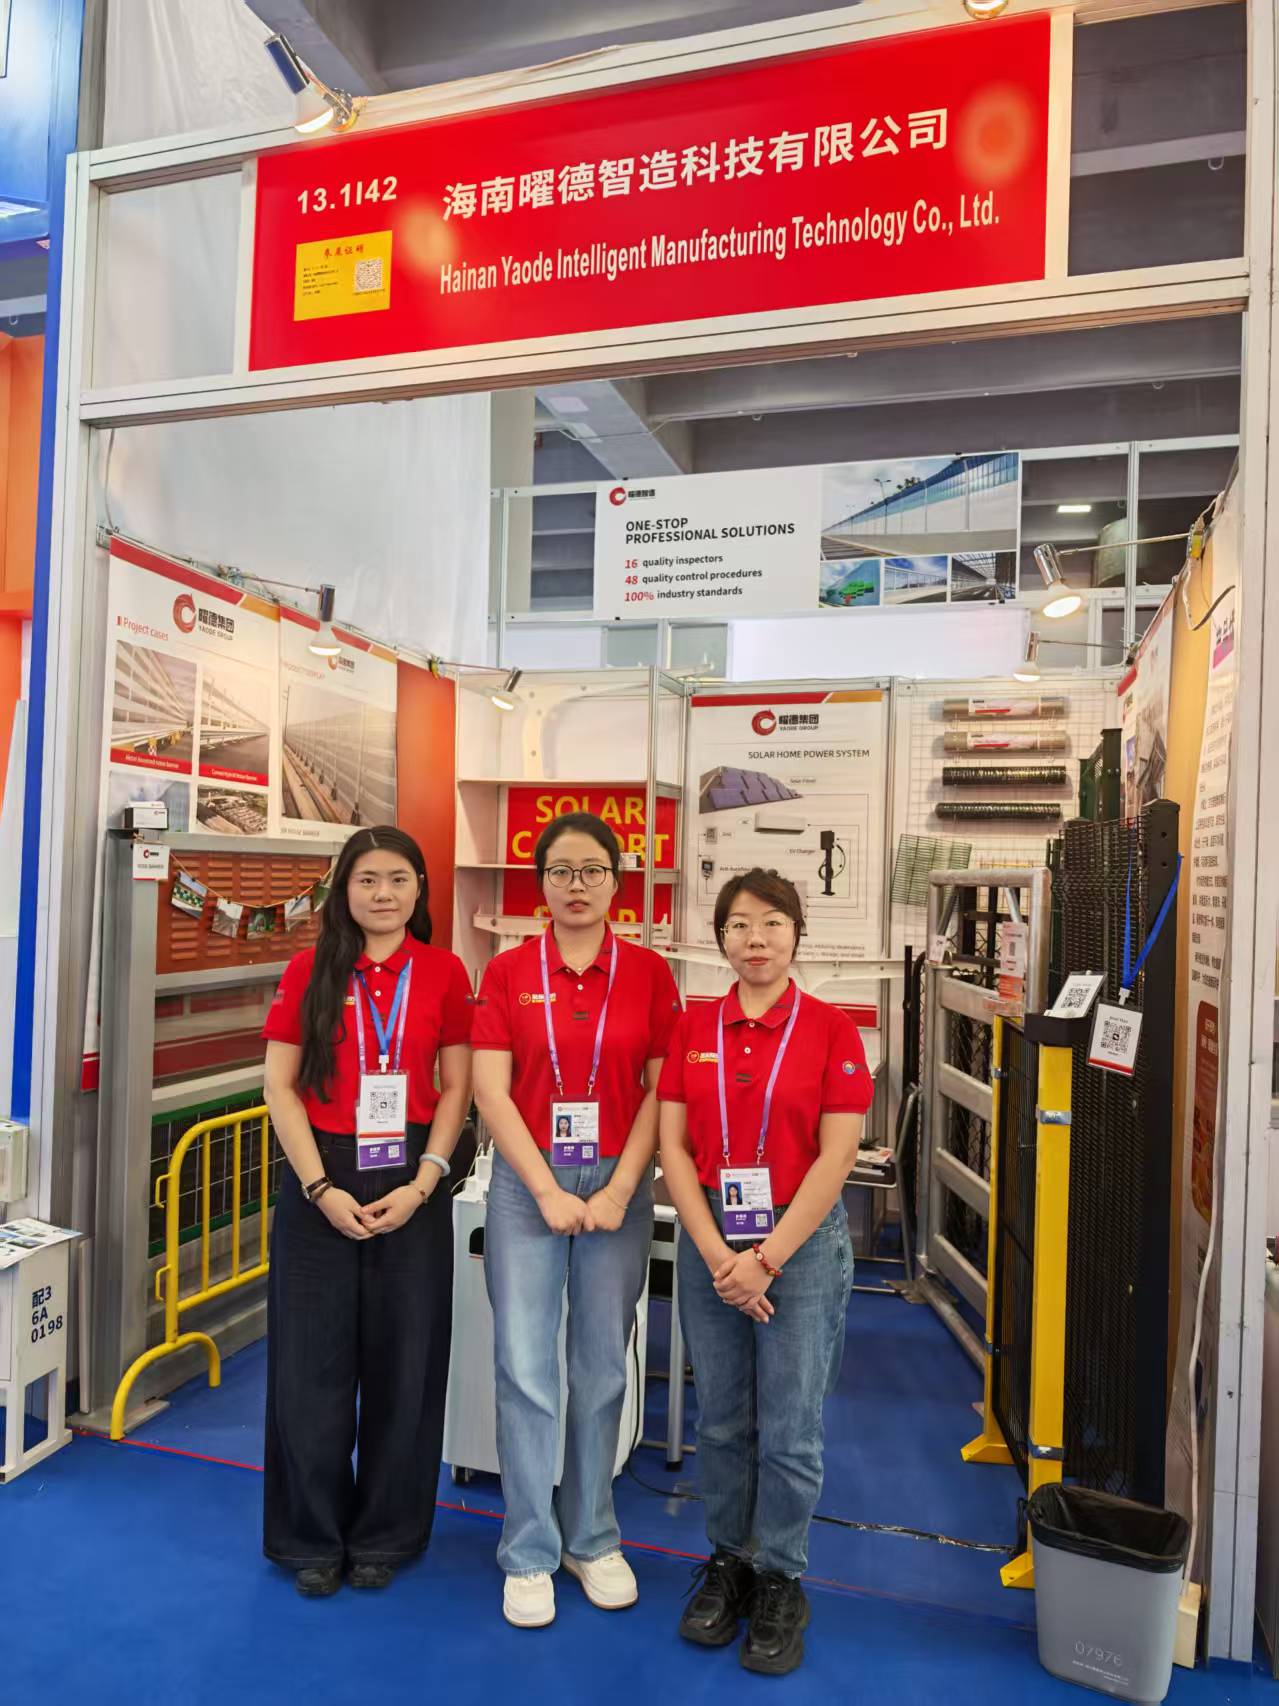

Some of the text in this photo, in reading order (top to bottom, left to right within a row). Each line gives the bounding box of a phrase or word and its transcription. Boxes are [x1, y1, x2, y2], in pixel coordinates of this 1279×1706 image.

[442, 108, 948, 221] 海南曜德智造科技有限公司
[440, 190, 1000, 294] Hainan Yaode Intelligent Manufacturing Technology Co., Ltd.
[625, 523, 796, 545] PROFESSIONAL SOLUTIONS
[626, 517, 689, 532] ONE-STOP
[625, 555, 724, 569] 16 quality inspectors
[625, 569, 763, 585] 48 quality control procedures
[624, 586, 743, 602] 100% industry standards
[123, 617, 169, 641] Project cases
[748, 749, 870, 759] SOLAR HOME POWER SYSTEM
[32, 1306, 49, 1325] 6A
[31, 1315, 63, 1343] 0198
